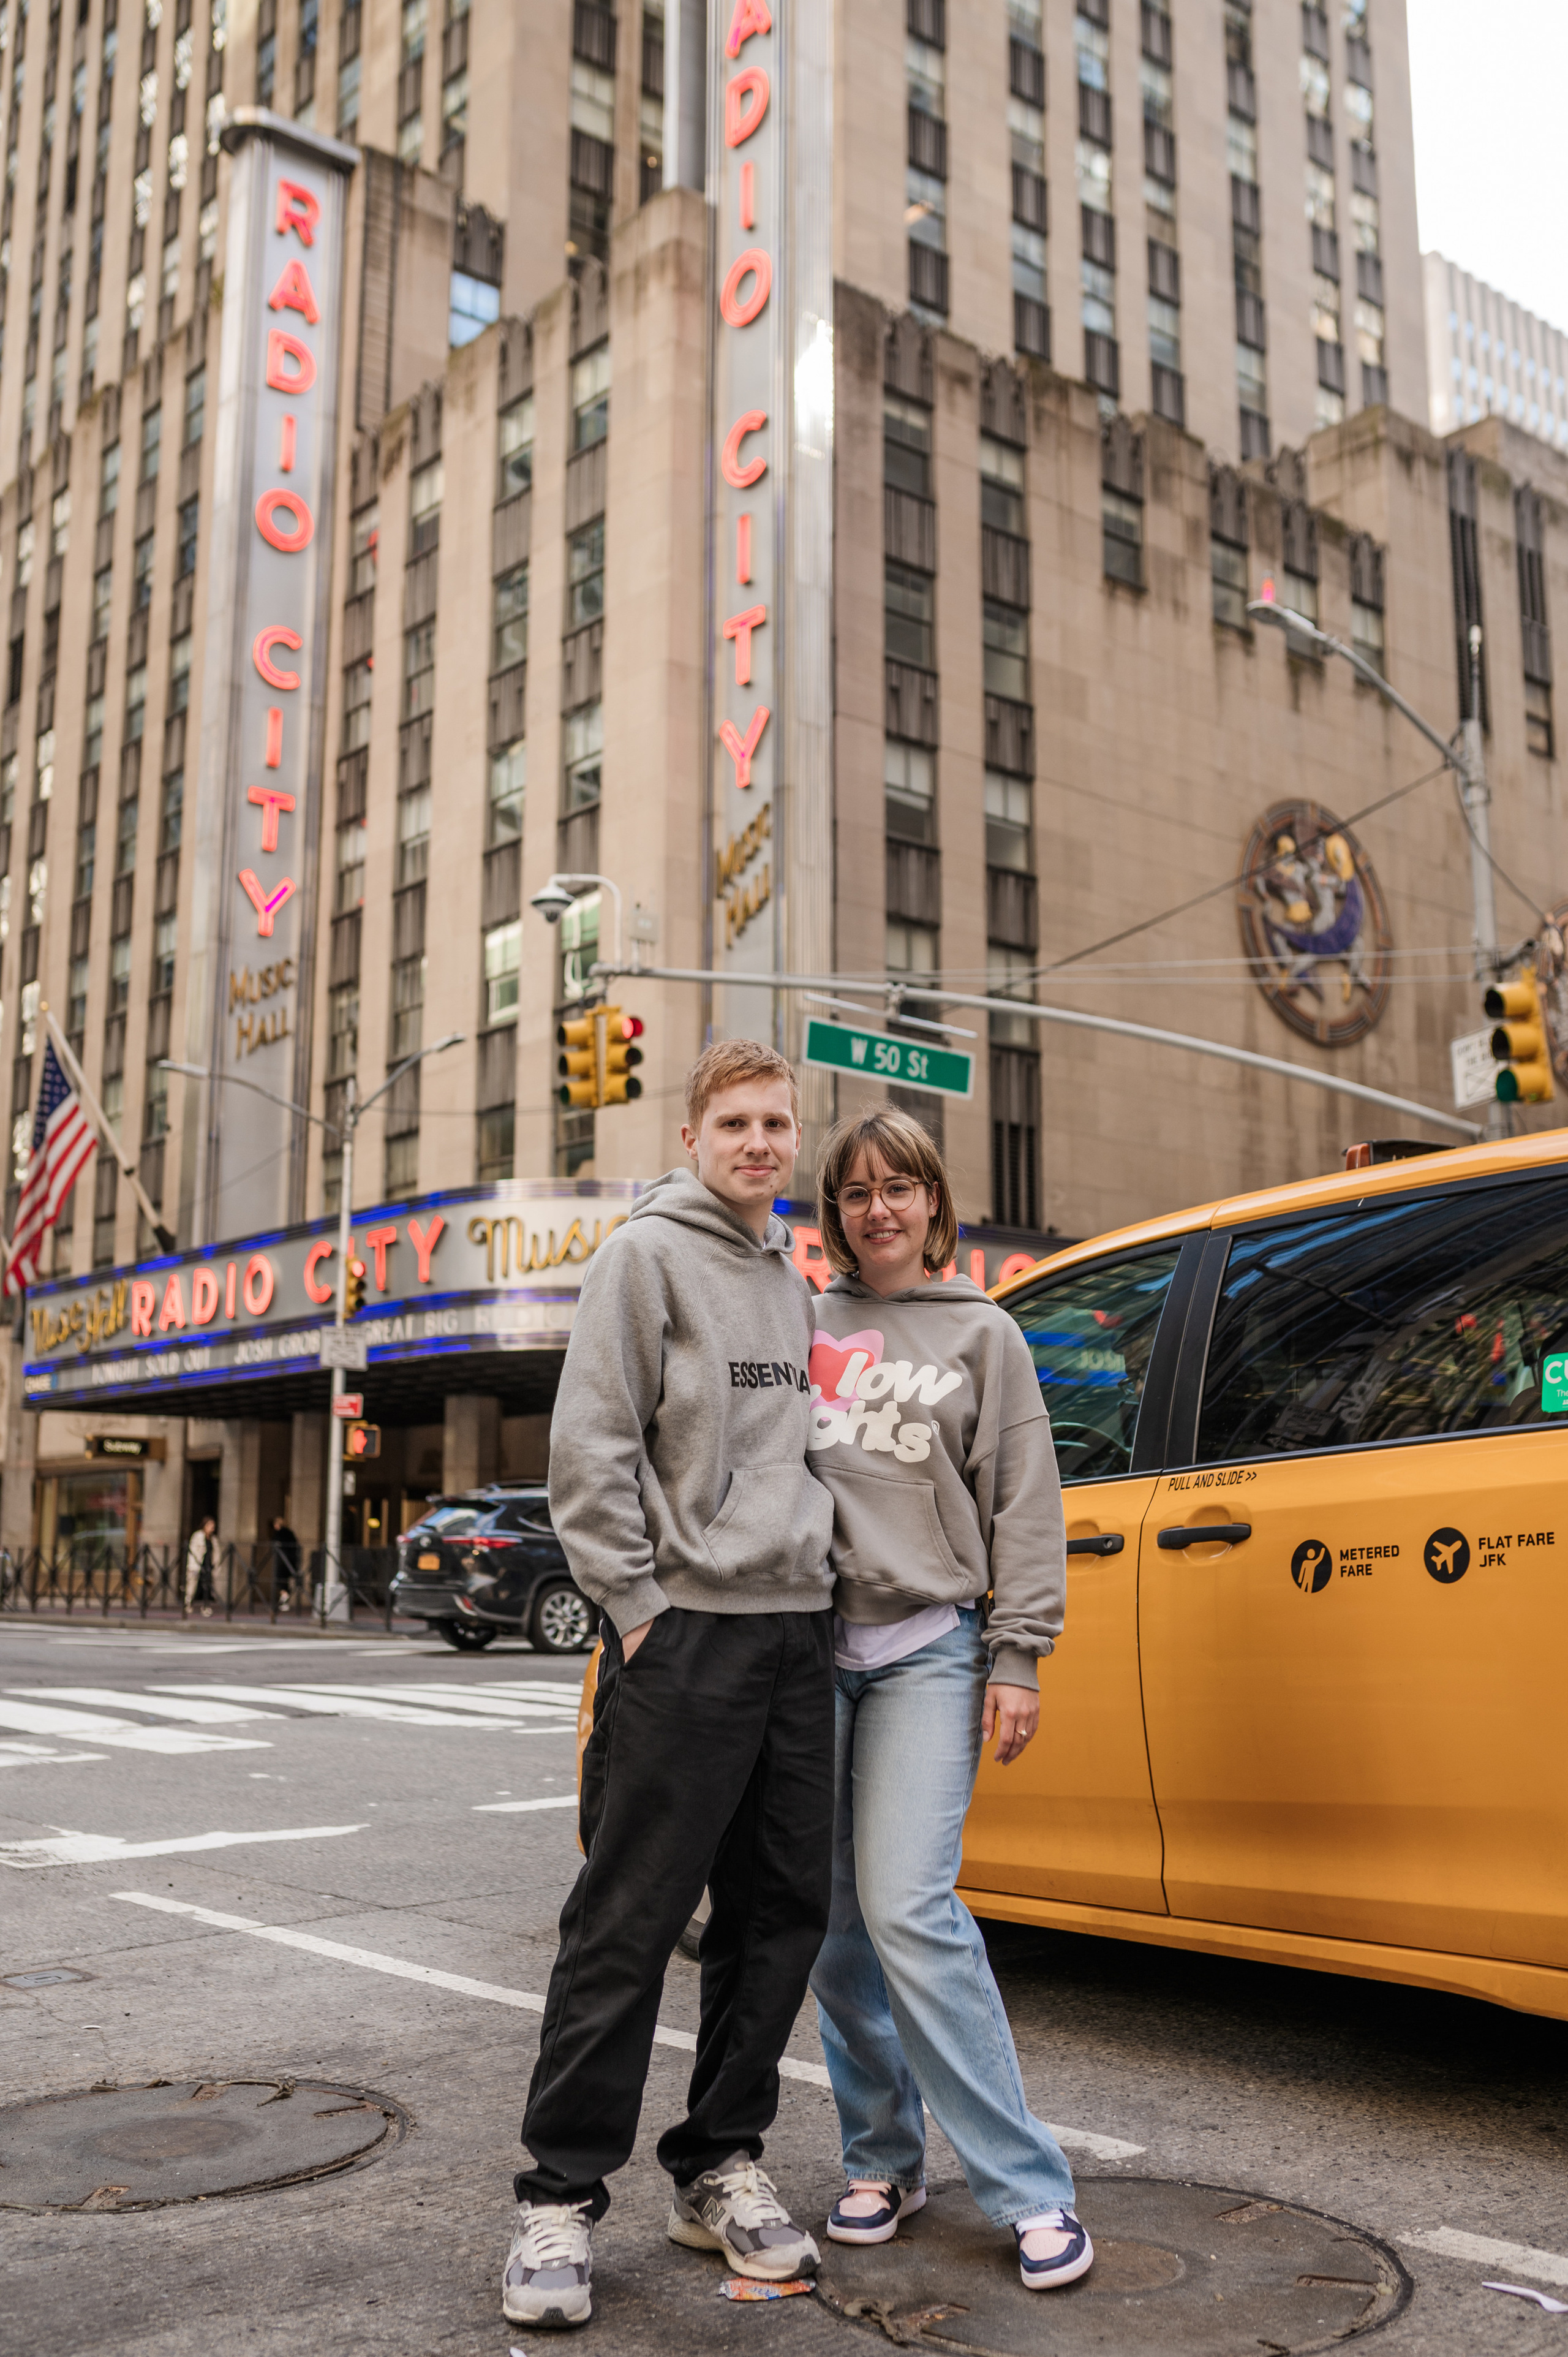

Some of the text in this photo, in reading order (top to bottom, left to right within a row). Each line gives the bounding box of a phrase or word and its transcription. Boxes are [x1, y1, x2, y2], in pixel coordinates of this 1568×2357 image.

[238, 178, 321, 937] RADIO CITY
[719, 409, 771, 789] CITY
[236, 1007, 293, 1062] HALL
[850, 1037, 930, 1080] W 50 St
[131, 1254, 274, 1337] RADIO
[423, 1308, 458, 1336] BIG
[1167, 1470, 1245, 1492] PULL AND SLIDE
[1340, 1545, 1400, 1562] METERED
[1478, 1532, 1555, 1550] FLAT FARE
[1340, 1564, 1373, 1578] FARE
[1479, 1553, 1507, 1568] JFK
